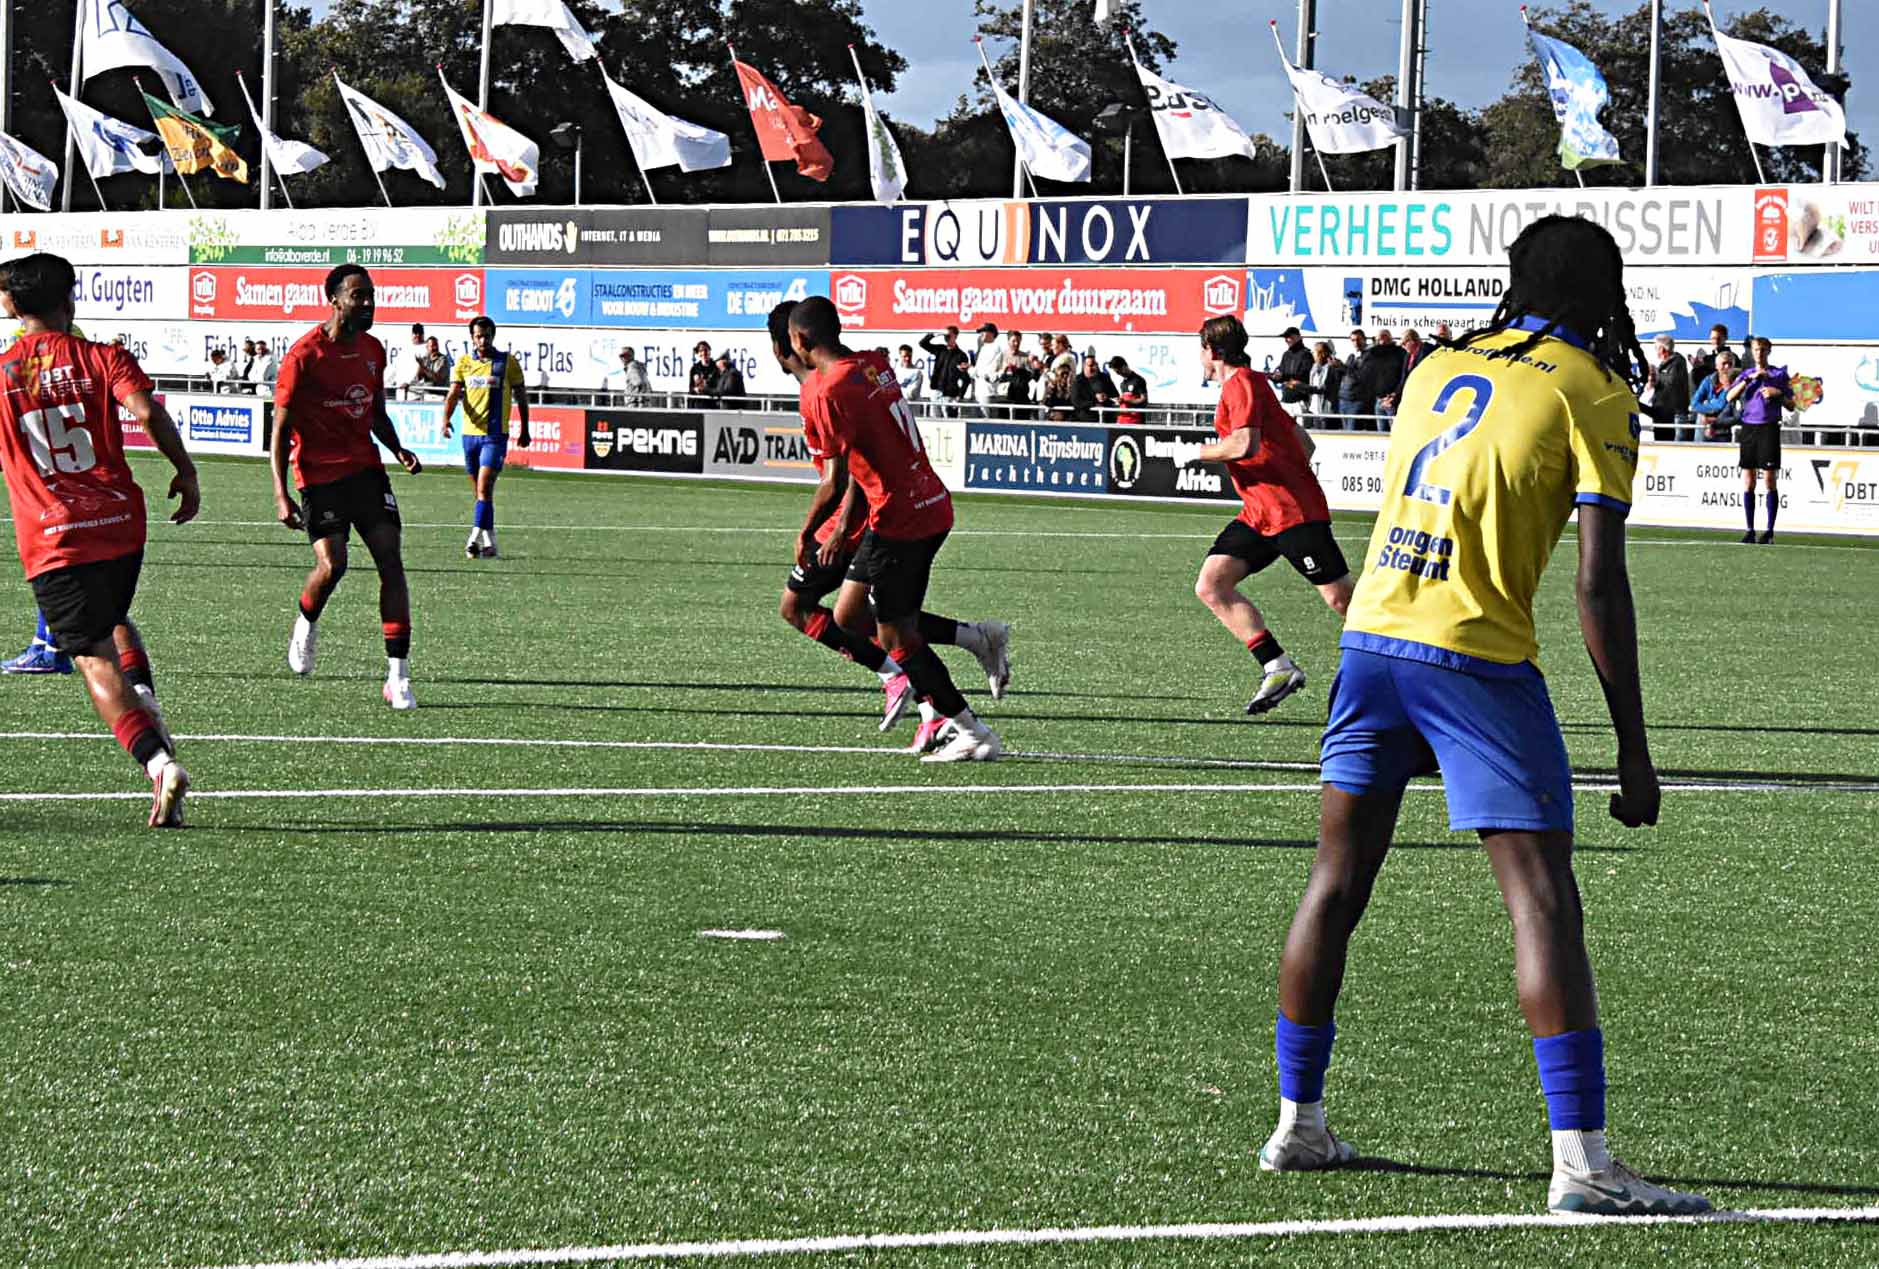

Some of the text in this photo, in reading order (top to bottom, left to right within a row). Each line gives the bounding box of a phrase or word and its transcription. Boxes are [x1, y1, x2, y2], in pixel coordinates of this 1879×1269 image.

[1849, 201, 1874, 214] WILT
[500, 223, 564, 251] OUTHANDS
[902, 204, 1152, 262] EQUINOX
[1270, 200, 1722, 256] VERHEES NOTRISSEN
[347, 248, 357, 262] 06
[363, 248, 371, 262] 19
[373, 248, 381, 262] 19
[92, 272, 153, 311] Gugten
[236, 276, 283, 306] Samen
[284, 283, 318, 313] gaan
[374, 285, 430, 308] urzaam
[506, 288, 521, 312] DE
[593, 283, 672, 298] STAALCONSTRUCTIES
[893, 278, 1166, 323] Samen gaan voor duurzaam
[1371, 277, 1503, 298] DMG HOLLAND
[727, 291, 743, 314] DE
[1371, 315, 1397, 327] Thuis
[1400, 315, 1410, 327] in
[537, 343, 573, 373] Plas
[643, 346, 684, 378] Fish
[192, 409, 250, 427] Otto Advies
[20, 402, 96, 478] 15
[970, 433, 1104, 467] MARINA Rijnsburg
[1403, 373, 1495, 506] 2
[1176, 468, 1222, 492] Africa
[1342, 476, 1385, 493] 085 90
[1646, 475, 1676, 492] DBT
[1845, 482, 1878, 500] DBT
[1701, 492, 1788, 508] AANSLTG
[1388, 526, 1454, 557] ongen
[1378, 545, 1450, 582] Steunt
